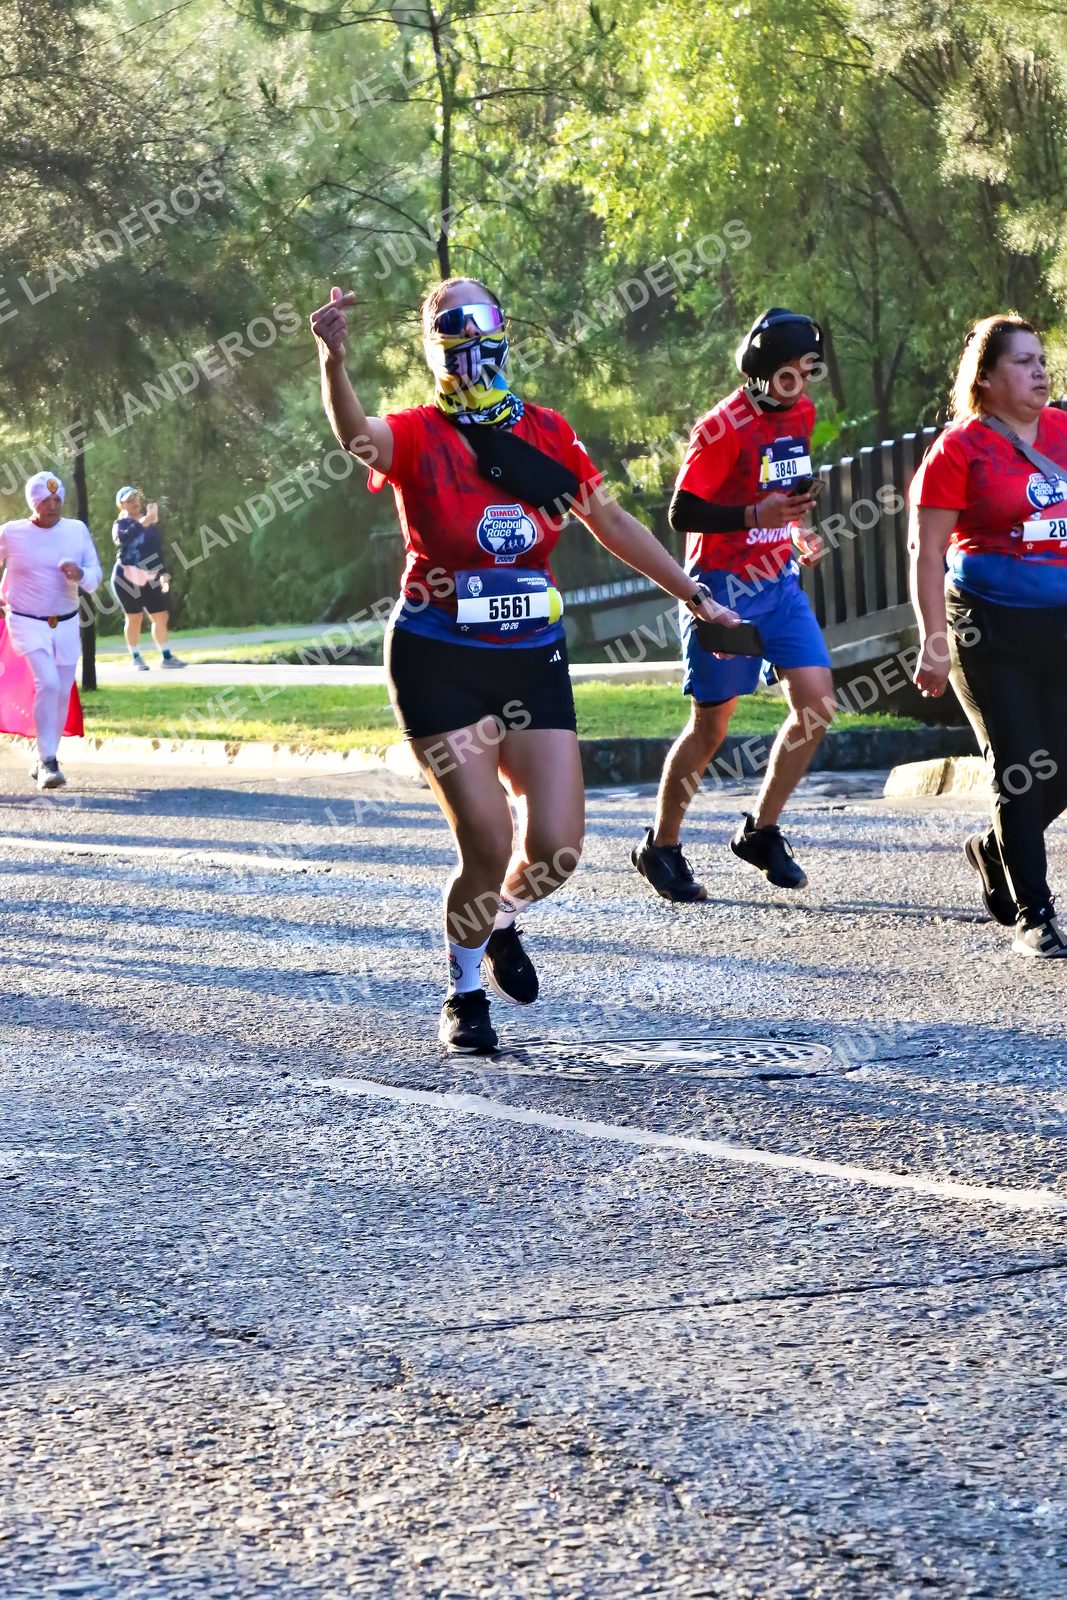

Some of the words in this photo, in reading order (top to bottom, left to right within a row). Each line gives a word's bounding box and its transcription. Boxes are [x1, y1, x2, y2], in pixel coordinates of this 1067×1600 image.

[775, 460, 797, 478] 3840
[492, 519, 521, 529] Global
[486, 529, 512, 538] Race
[489, 595, 530, 620] 5561
